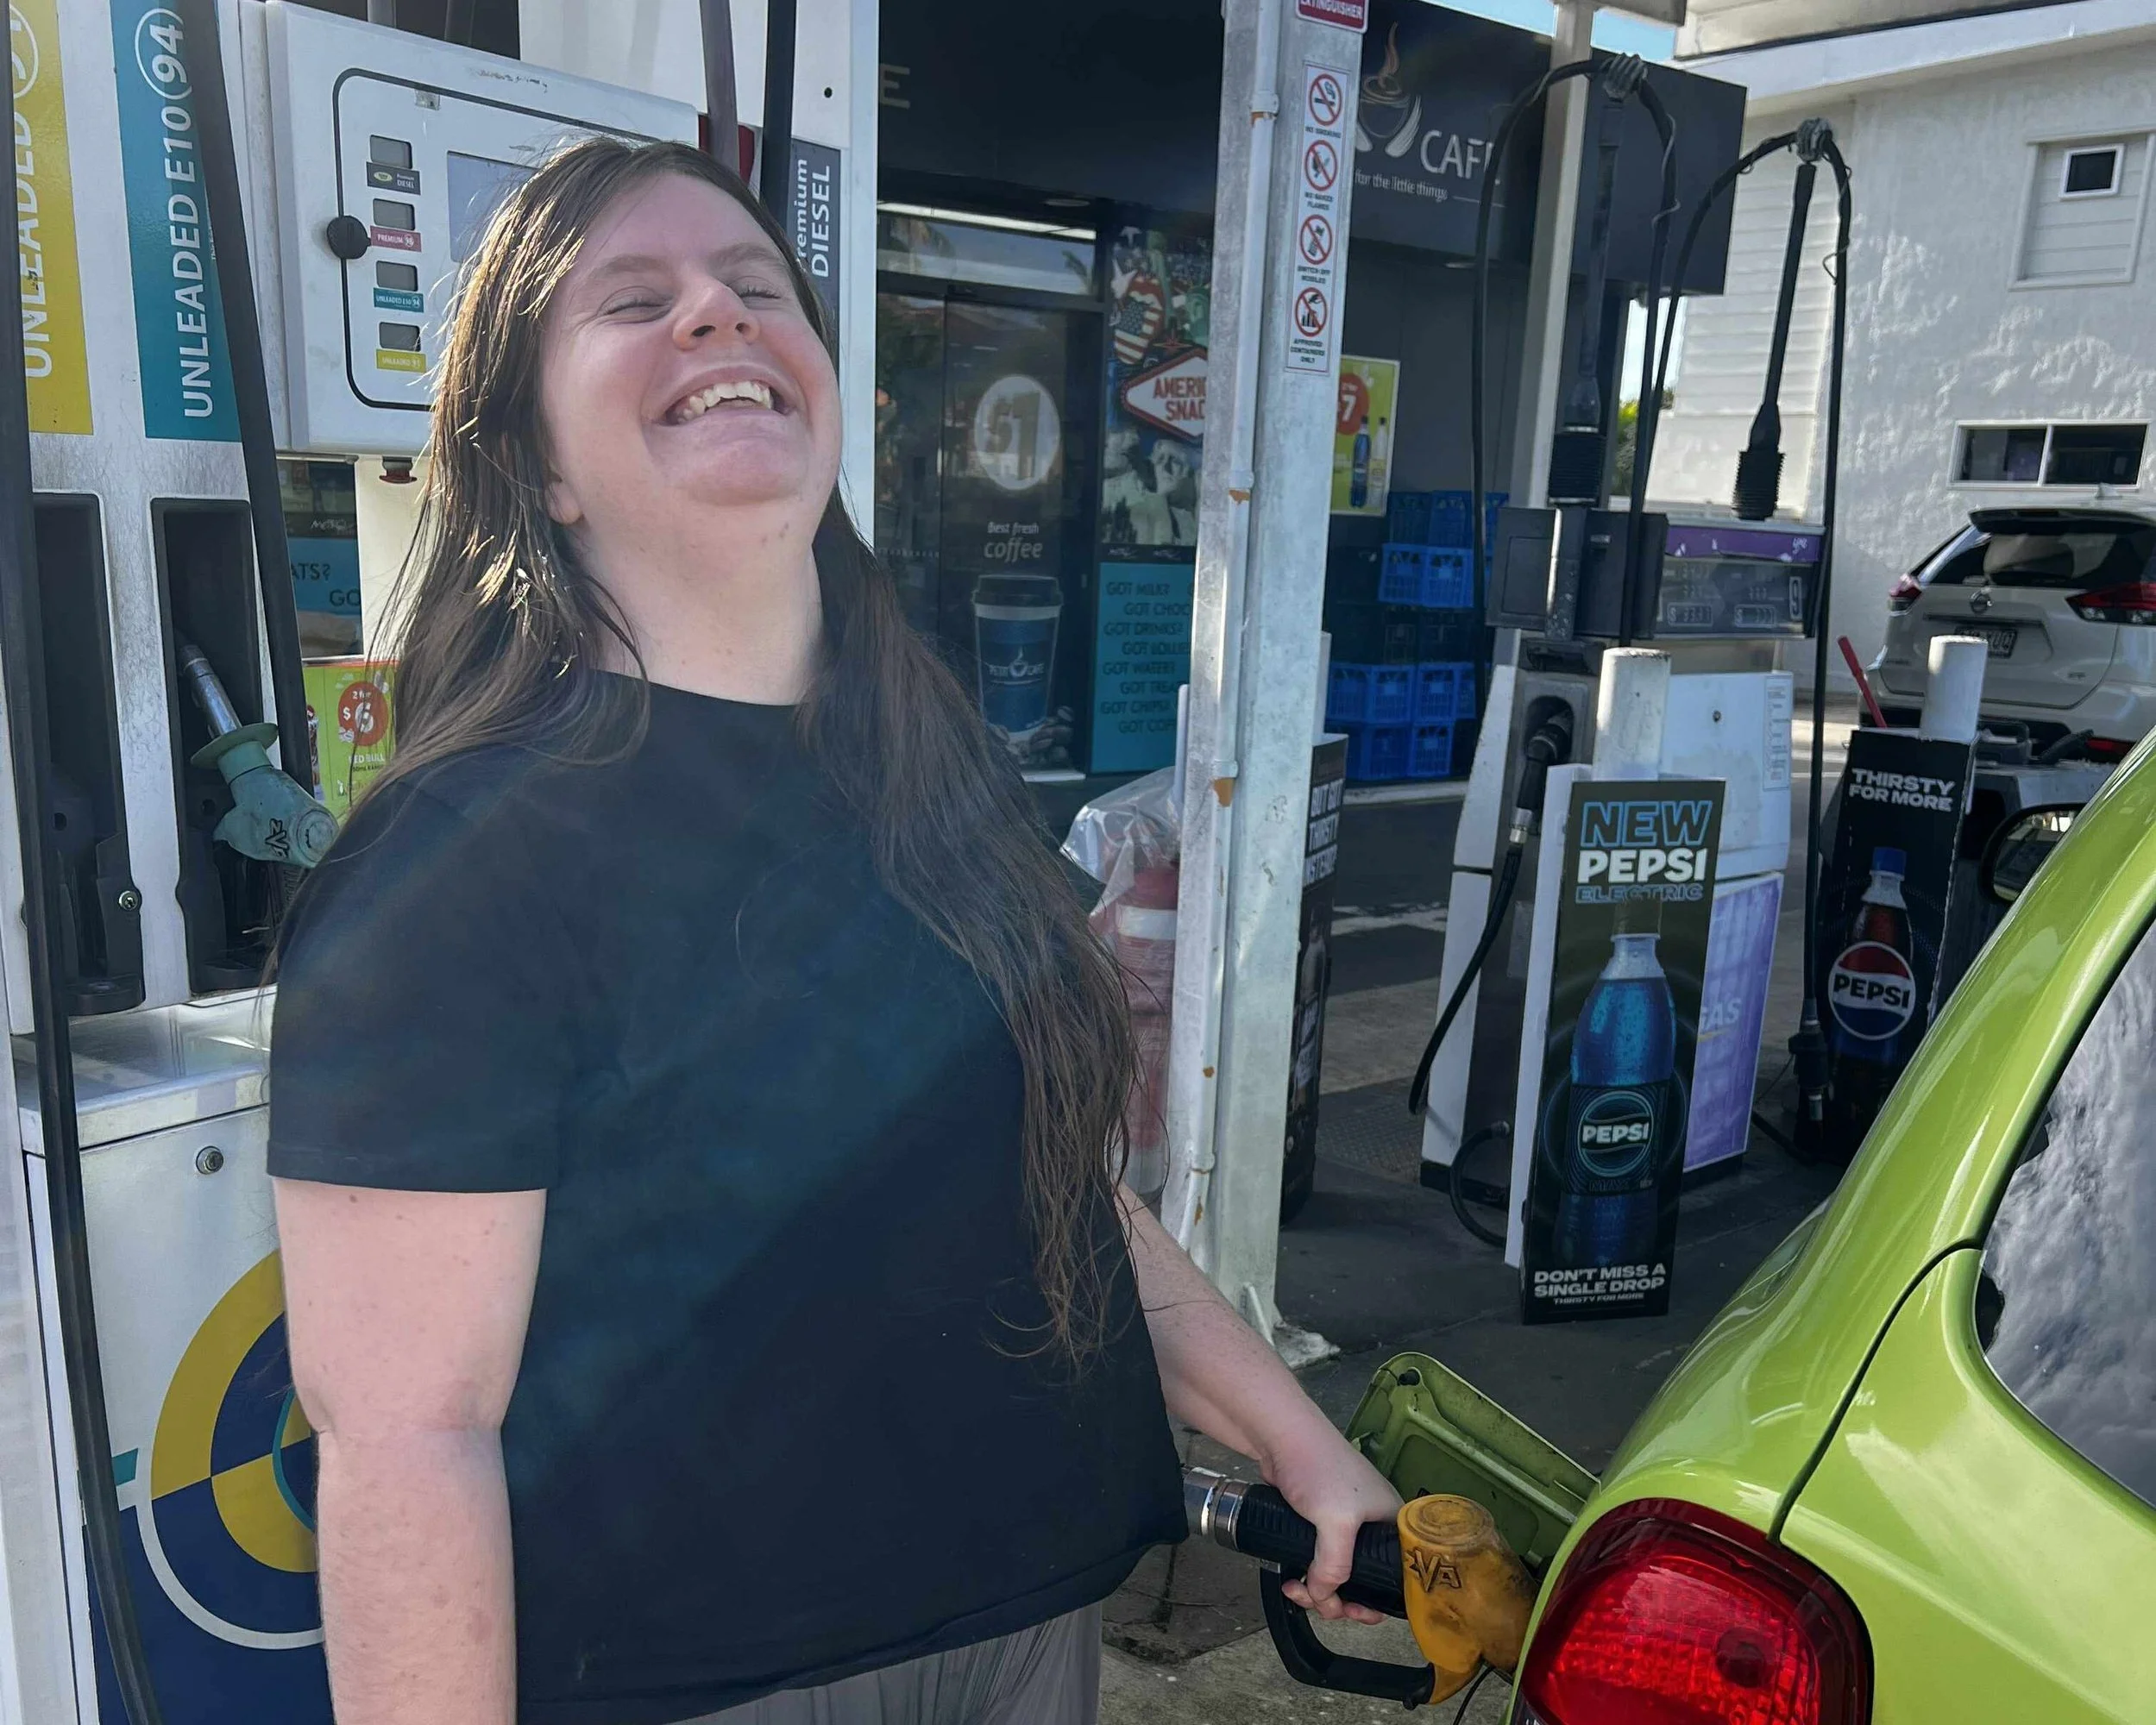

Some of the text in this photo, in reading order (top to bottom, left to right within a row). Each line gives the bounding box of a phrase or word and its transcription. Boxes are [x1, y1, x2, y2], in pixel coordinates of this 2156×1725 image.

[1372, 173, 1391, 189] the
[1392, 175, 1416, 194] little
[1417, 181, 1448, 203] things
[149, 19, 212, 417] UNLEADED E10 94
[795, 159, 808, 262] remium
[811, 166, 830, 278] DIESEL
[14, 110, 53, 380] UNLEADED
[377, 233, 403, 244] PREMIUM
[987, 521, 1040, 536] Best fresh
[984, 536, 1043, 563] coffee
[1106, 581, 1132, 596] GOT
[1124, 602, 1150, 616] GOT
[1103, 622, 1130, 636] GOT
[1122, 642, 1148, 656] GOT
[1103, 662, 1128, 675] GOT
[1119, 681, 1147, 694] GOT
[1101, 701, 1128, 714] GOT
[1118, 720, 1144, 733] GOT
[1851, 768, 1958, 797] THIRSTY
[1849, 782, 1955, 812] FOR MORE
[1580, 800, 1713, 848] NEW
[1577, 848, 1708, 884] PEPSI
[1575, 883, 1704, 905] ELECTRIC
[1832, 973, 1911, 1009] PEPSI
[1582, 1122, 1650, 1144] PEPSI
[1534, 1262, 1667, 1283] DON'T MISS A
[1534, 1276, 1665, 1297] SINGLE DROP
[1554, 1295, 1595, 1305] THIRSTY
[1616, 1292, 1644, 1301] MORE
